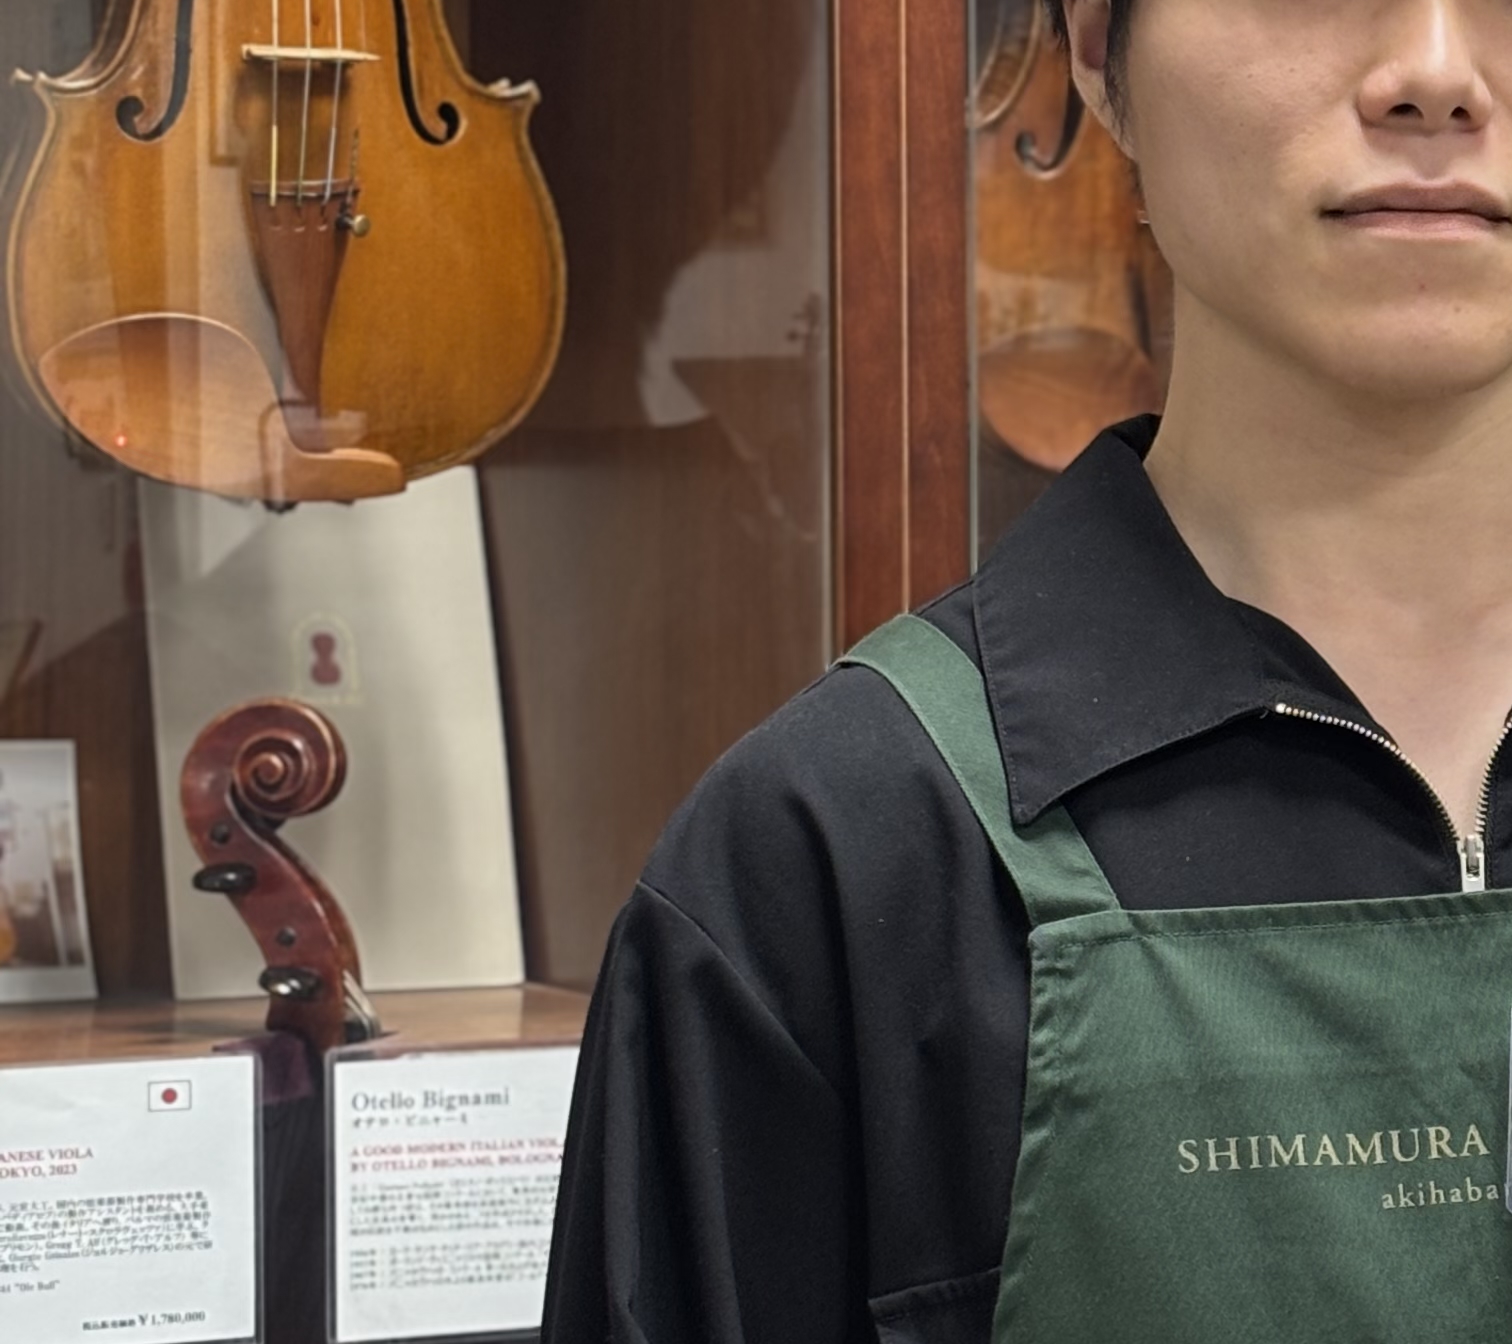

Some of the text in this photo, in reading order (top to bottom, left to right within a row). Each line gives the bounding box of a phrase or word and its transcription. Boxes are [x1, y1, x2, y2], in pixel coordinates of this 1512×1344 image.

[351, 1087, 510, 1112] Otello Bignami
[48, 1146, 95, 1162] VIOLA
[1177, 1123, 1491, 1174] SHIMAMURA
[49, 1163, 78, 1177] 2023
[1381, 1177, 1501, 1210] akihaba
